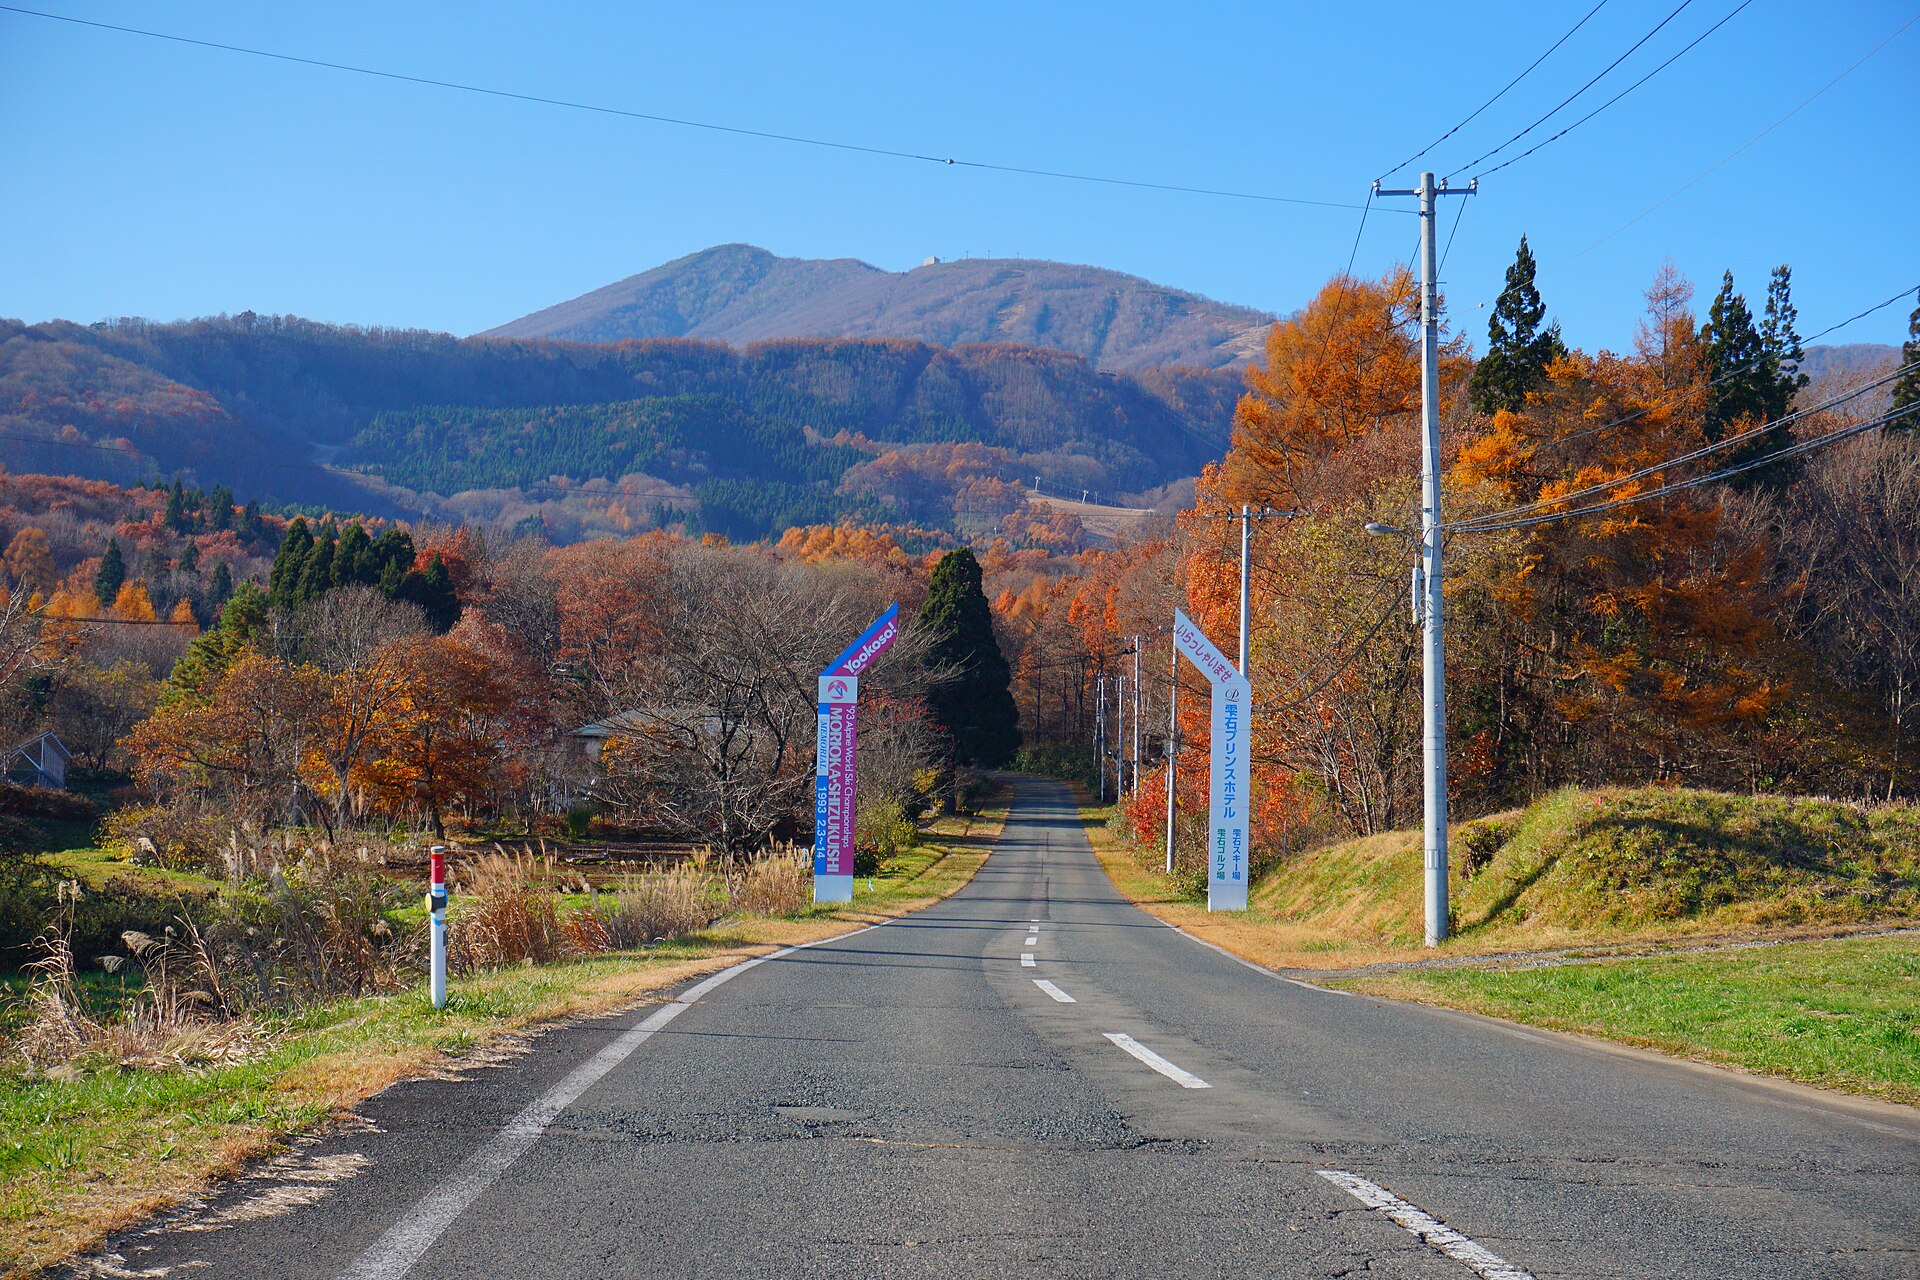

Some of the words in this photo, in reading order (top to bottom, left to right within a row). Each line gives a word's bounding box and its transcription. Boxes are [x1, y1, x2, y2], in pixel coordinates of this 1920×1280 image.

[843, 621, 897, 673] Yookoso!
[1176, 624, 1233, 683] いらっしゃいませ
[819, 721, 828, 770] MEMORIAL
[844, 721, 855, 746] Alpine
[844, 746, 854, 772] World
[844, 773, 854, 786] Ski
[1223, 704, 1238, 819] 雫石プリンスホテル
[817, 786, 827, 814] 1993
[841, 787, 853, 848] Championships
[1216, 828, 1226, 881] 雫石ゴルフ場
[1231, 828, 1242, 881] 雫石スキー場
